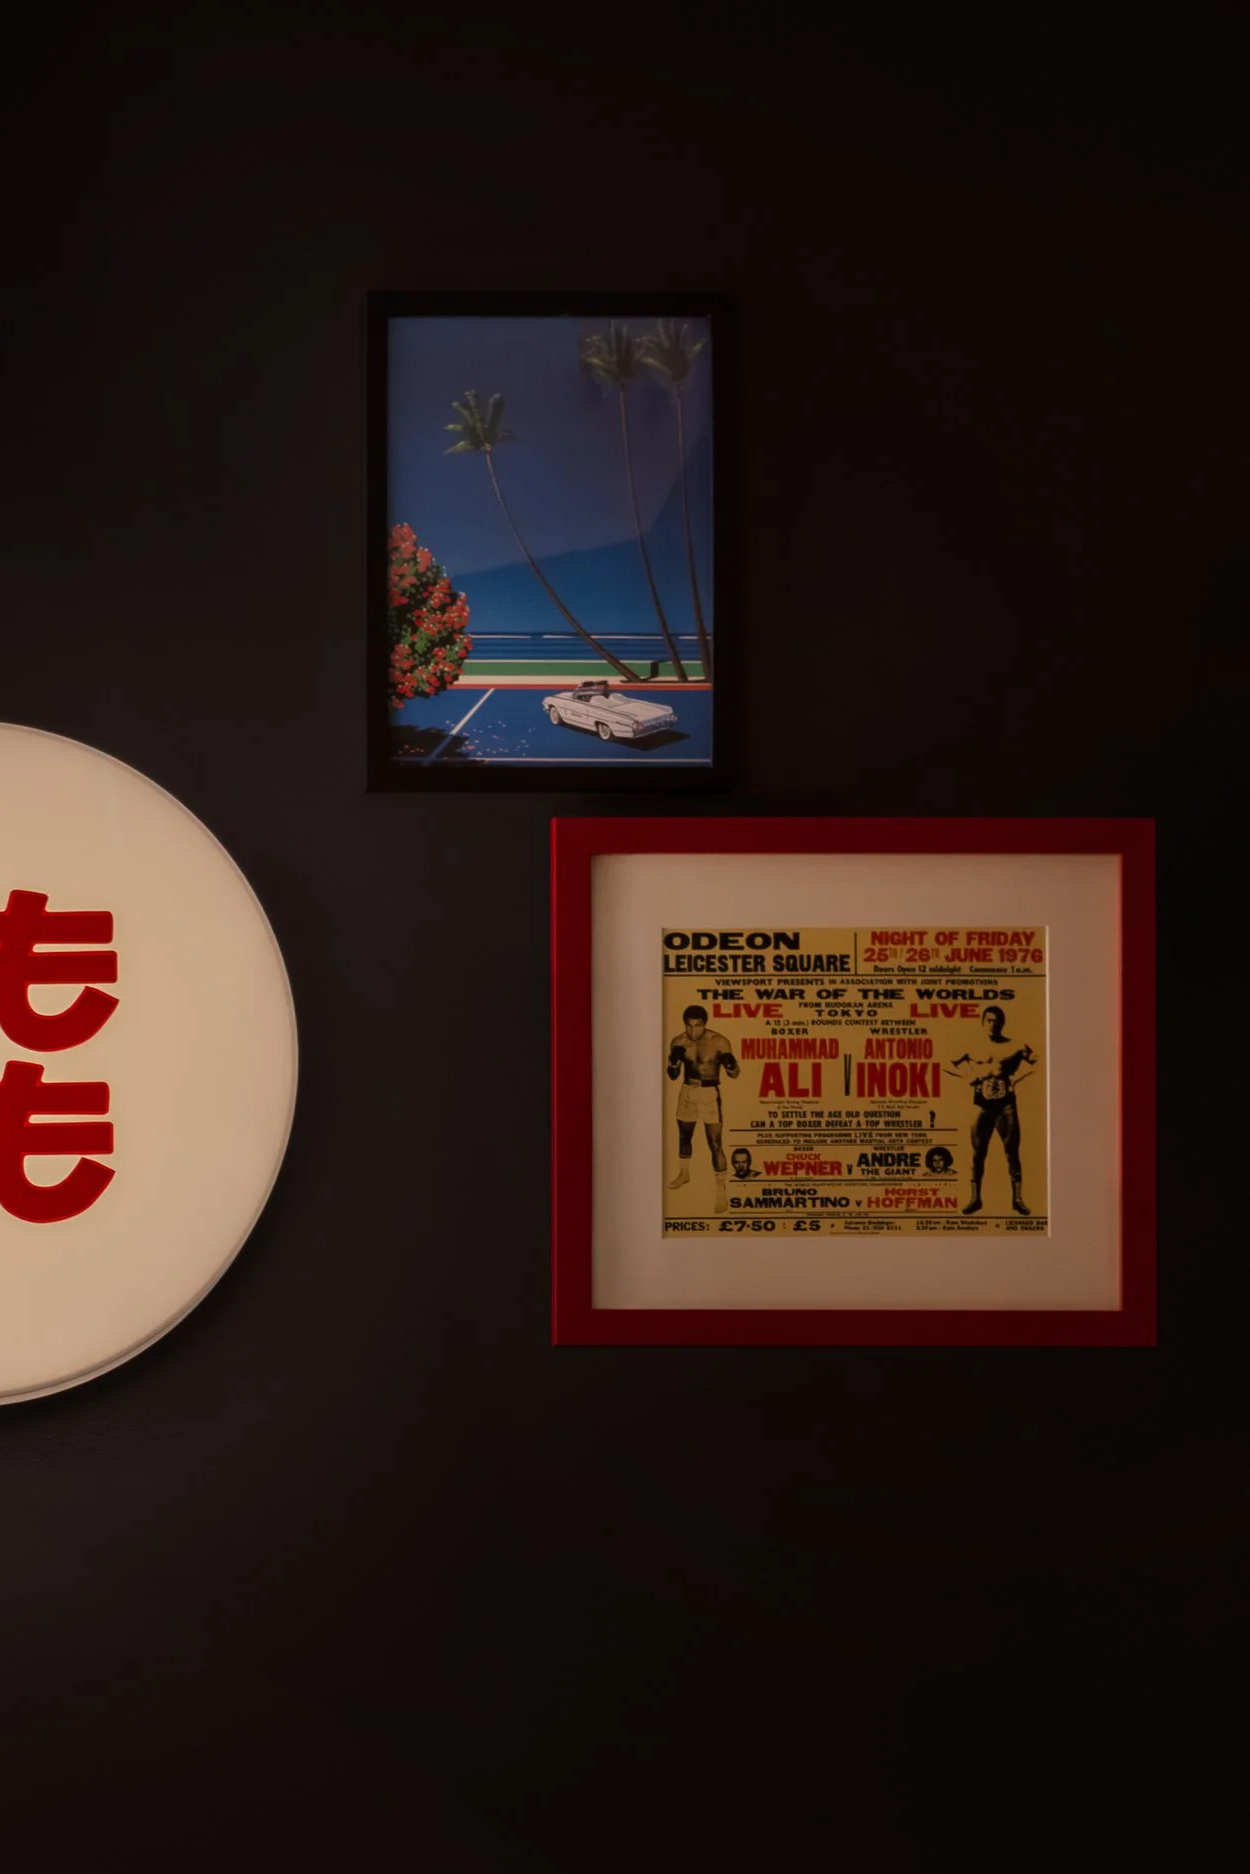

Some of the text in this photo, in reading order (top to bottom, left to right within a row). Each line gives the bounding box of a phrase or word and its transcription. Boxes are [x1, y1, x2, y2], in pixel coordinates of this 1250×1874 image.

[664, 932, 800, 950] ODEON
[871, 931, 1035, 946] NIGHT OF FRIDAY
[945, 948, 993, 962] JUNE
[998, 948, 1043, 962] 1976
[664, 954, 851, 973] LEICESTER SQUARE
[697, 989, 1015, 1000] THE WAR OF THE WORLDS
[713, 1003, 784, 1018] LIVE
[910, 1003, 981, 1018] LIVE
[741, 1038, 840, 1060] MUHAMMAD
[865, 1038, 933, 1060] ANTONIO
[759, 1062, 822, 1098] ALI
[857, 1062, 941, 1098] INOKI
[751, 1120, 922, 1128] CAN A TOP BOXER DEFEAT A TOP WRESTLER
[786, 1153, 821, 1161] CHUCK
[857, 1153, 921, 1167] ANDRE
[763, 1161, 842, 1176] WEPNER
[860, 1168, 916, 1176] THE GIANT
[762, 1188, 817, 1196] BRUNO
[884, 1188, 940, 1196] HORST
[730, 1197, 850, 1208] SAMMARTINO
[867, 1197, 958, 1208] HOFFMAN
[665, 1221, 710, 1231] PRICES:
[792, 1221, 820, 1231] £5
